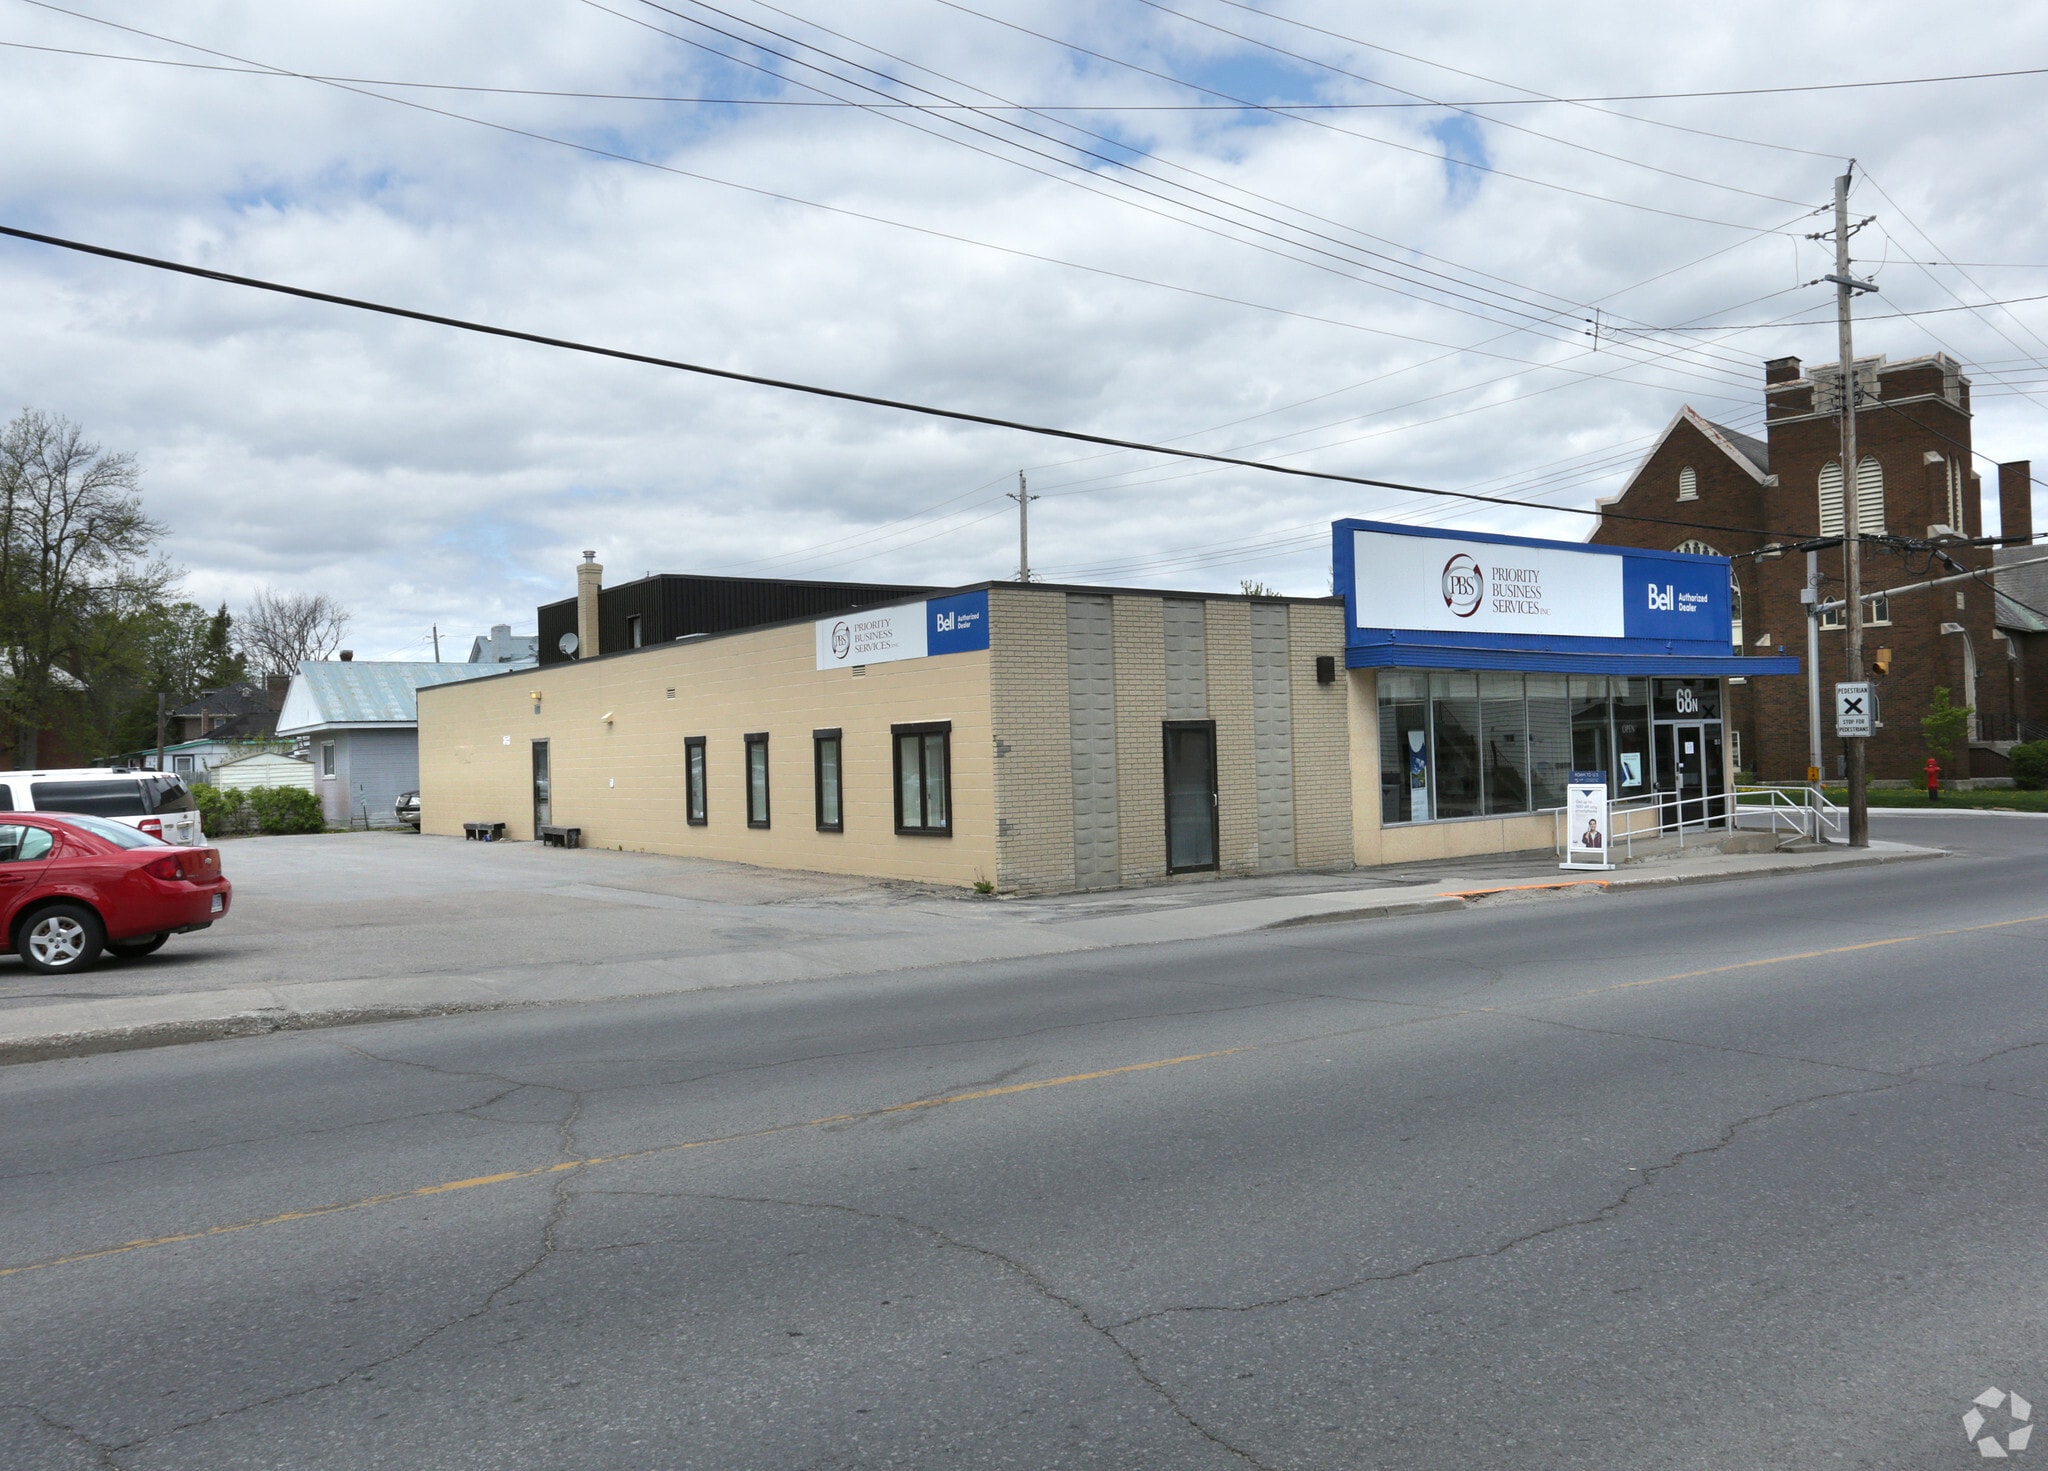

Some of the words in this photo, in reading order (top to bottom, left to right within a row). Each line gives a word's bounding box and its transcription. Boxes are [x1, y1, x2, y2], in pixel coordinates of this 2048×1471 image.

[1492, 567, 1540, 583] PRIORITY
[1450, 576, 1475, 595] PBS
[1492, 583, 1542, 600] BUSINESS
[1648, 583, 1674, 611] Bell
[1678, 592, 1708, 603] Authorized
[1492, 599, 1540, 615] SERVICES
[1678, 603, 1697, 612] Dealer
[937, 611, 955, 633] Bell
[957, 612, 979, 622] Authorized
[854, 618, 891, 632] PRIORITY
[957, 621, 971, 629] Dealer
[854, 629, 893, 643] BUSINESS
[854, 640, 891, 653] SERVICES
